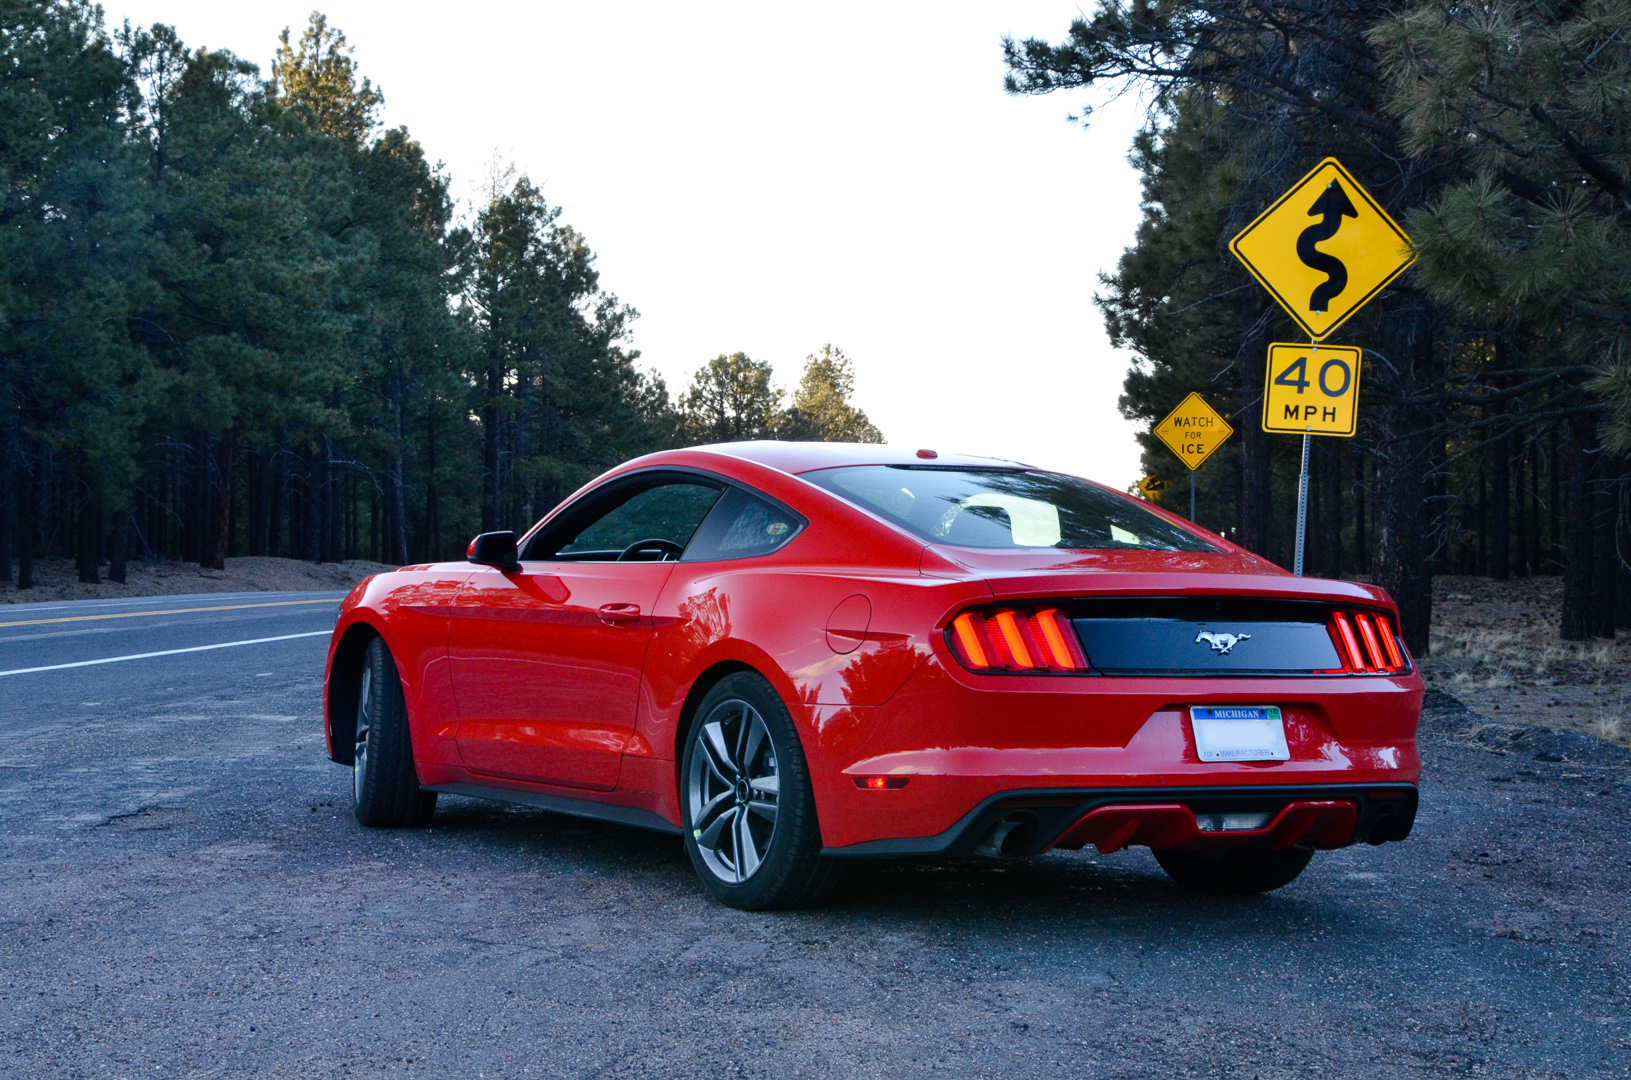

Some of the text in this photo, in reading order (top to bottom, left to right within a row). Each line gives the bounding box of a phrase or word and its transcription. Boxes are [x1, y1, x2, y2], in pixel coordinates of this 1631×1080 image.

[1274, 357, 1351, 397] 40
[1284, 404, 1336, 422] MPH
[1174, 417, 1213, 427] WATCH
[1182, 444, 1204, 454] ICE
[1214, 710, 1259, 718] MICHIGAN
[1220, 749, 1269, 757] MANUFACTURER
